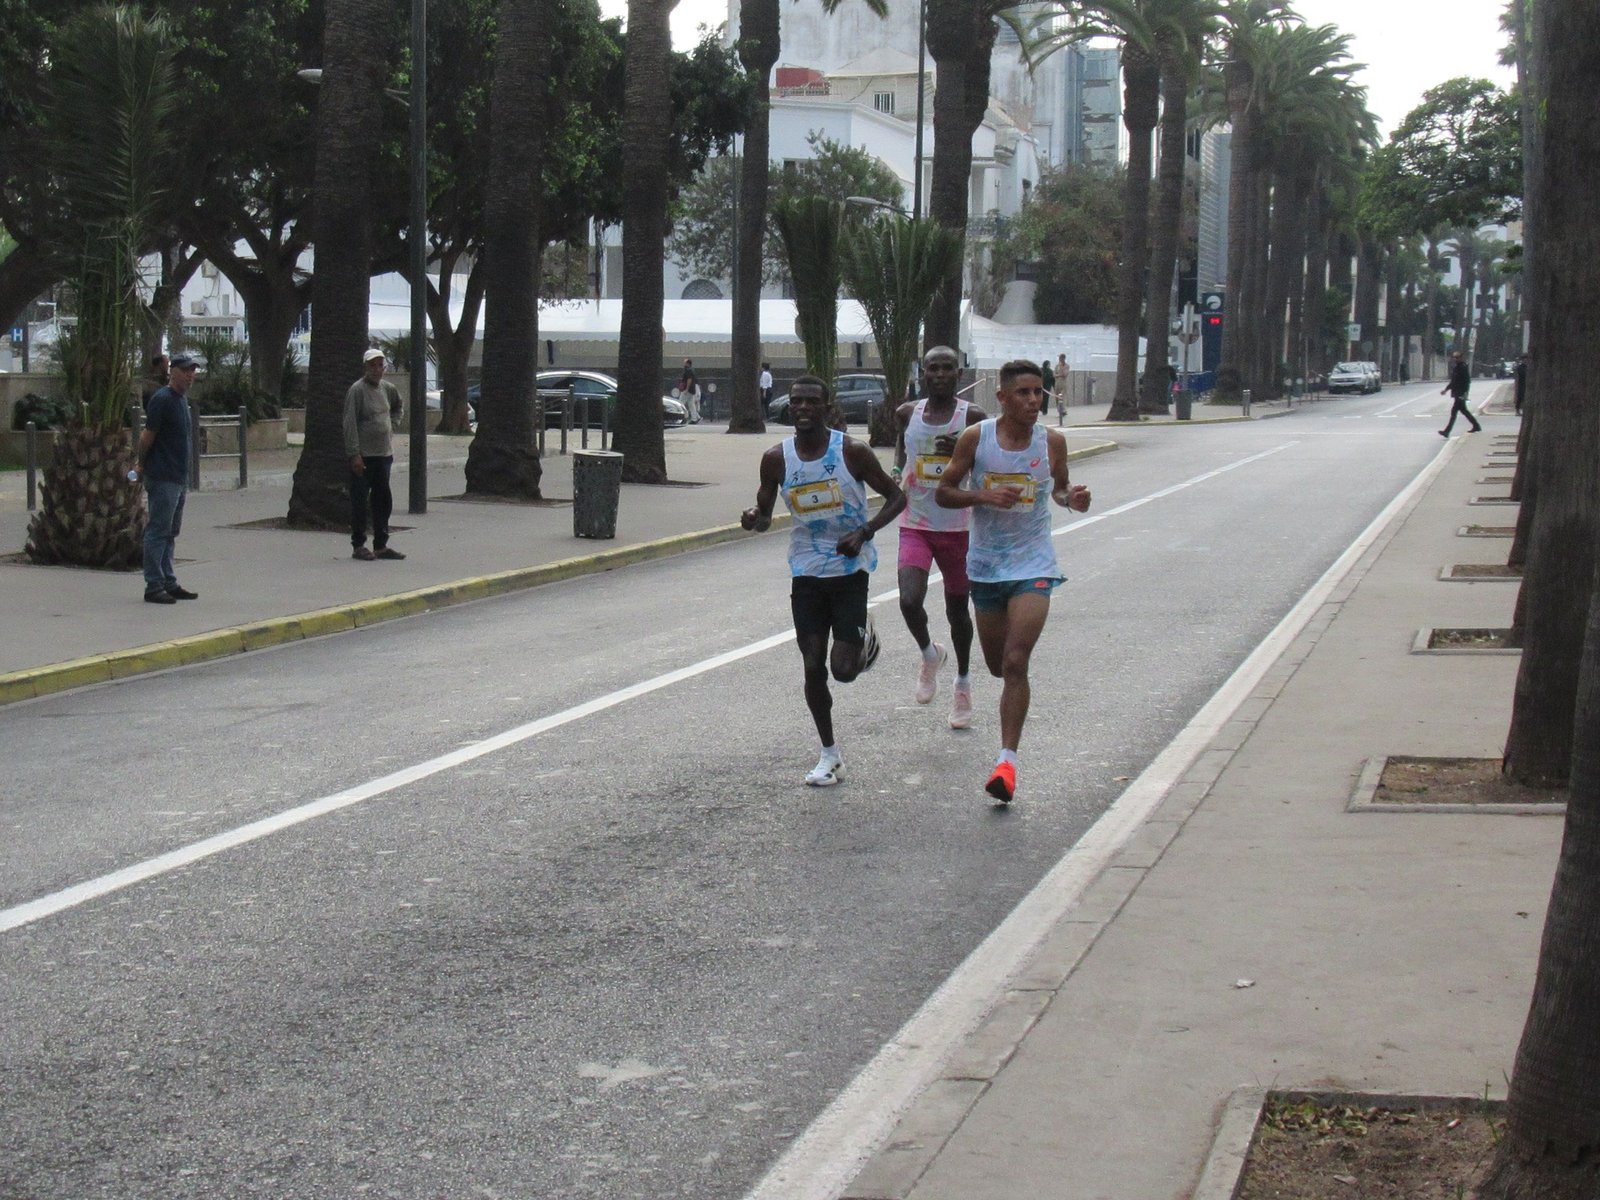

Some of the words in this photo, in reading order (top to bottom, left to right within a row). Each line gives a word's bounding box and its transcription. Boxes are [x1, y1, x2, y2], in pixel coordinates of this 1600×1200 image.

[13, 328, 23, 342] H
[935, 466, 943, 474] 6
[812, 495, 819, 504] 3
